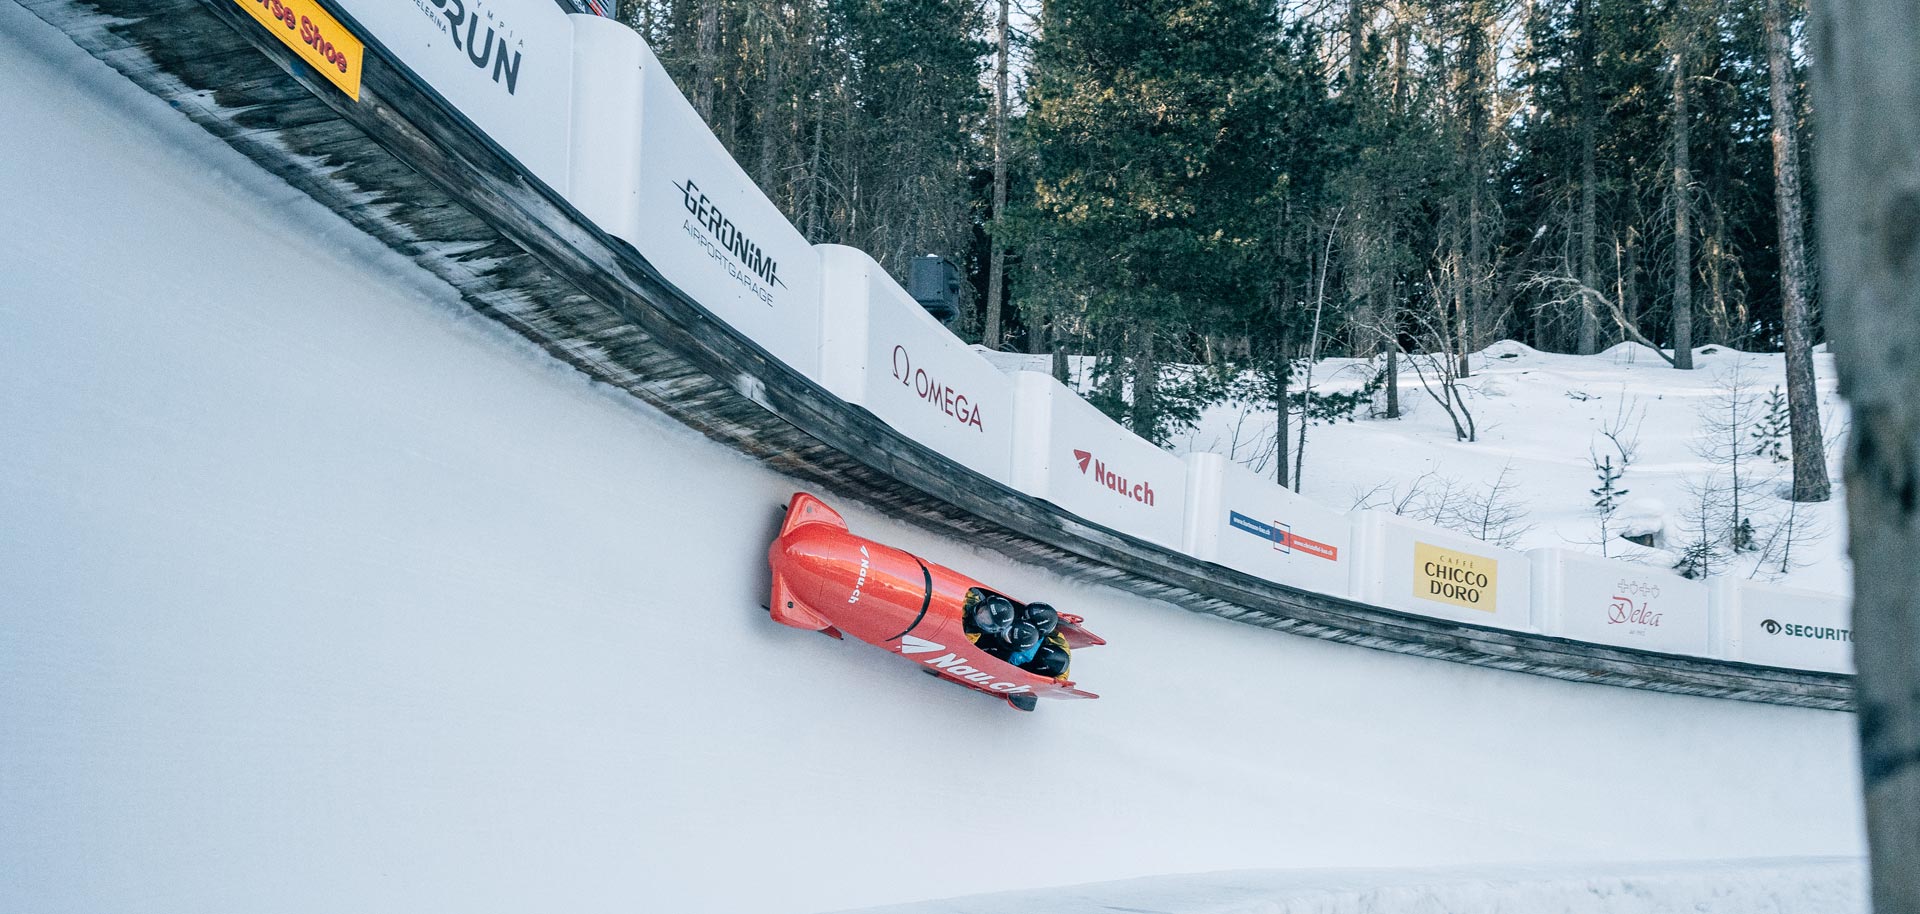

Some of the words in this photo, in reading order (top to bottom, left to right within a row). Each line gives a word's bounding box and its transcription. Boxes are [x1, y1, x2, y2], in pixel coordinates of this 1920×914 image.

[300, 15, 347, 73] Shoe
[430, 0, 522, 96] RUN
[683, 219, 774, 308] AIRPORTGARAGE
[915, 368, 983, 432] OMEGA
[1095, 458, 1154, 507] Nau.ch
[847, 558, 869, 604] Nau.ch
[1424, 561, 1488, 588] CHICCO
[1607, 595, 1664, 627] Delea
[923, 652, 1032, 694] Nau.ch
